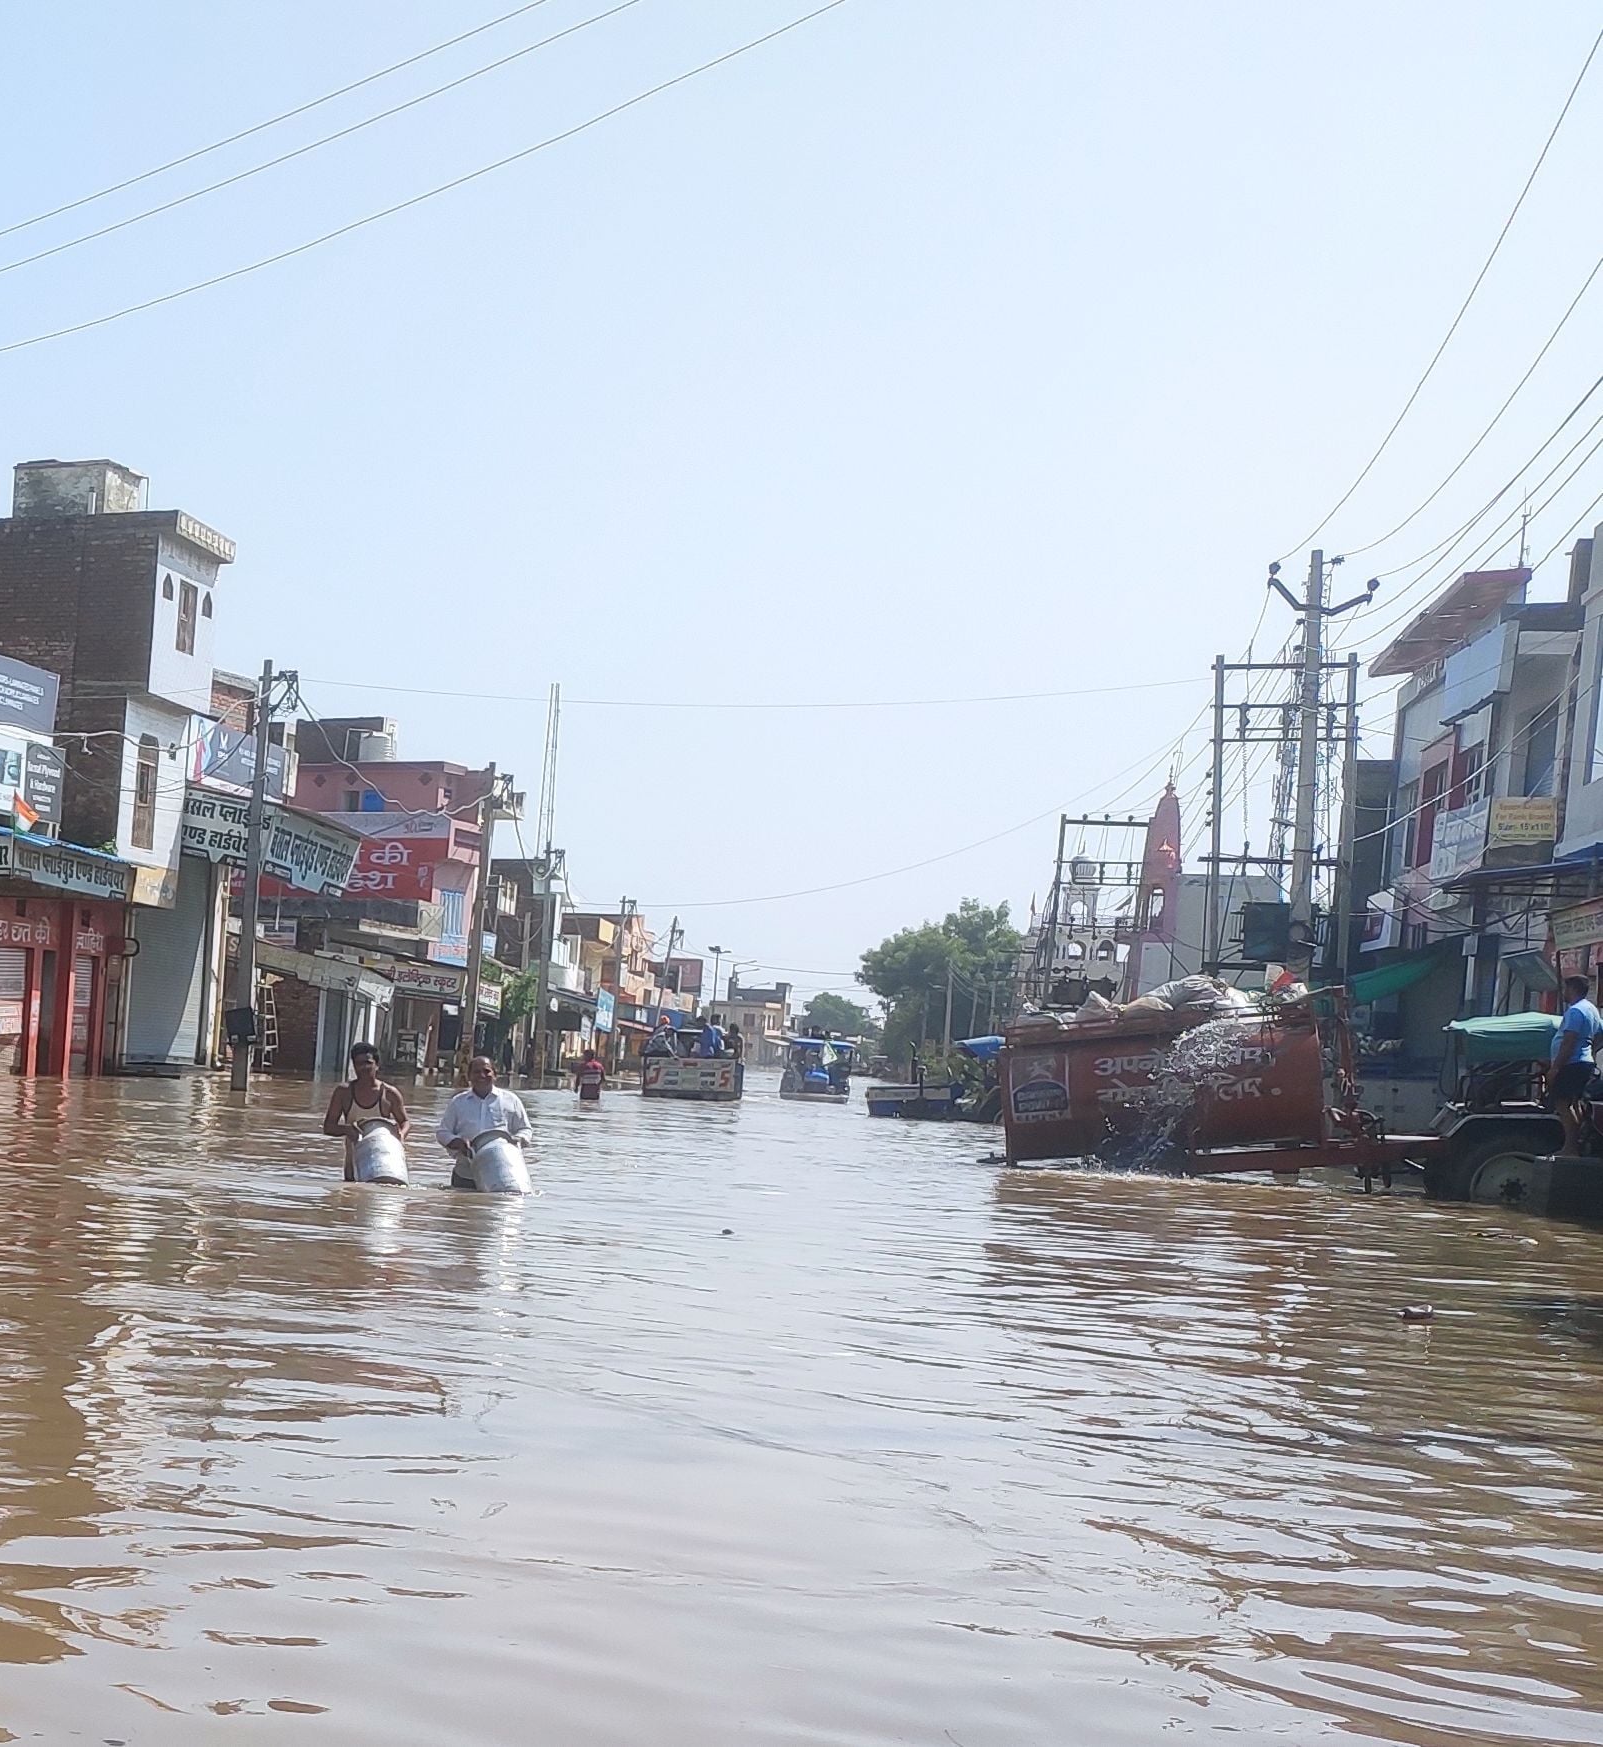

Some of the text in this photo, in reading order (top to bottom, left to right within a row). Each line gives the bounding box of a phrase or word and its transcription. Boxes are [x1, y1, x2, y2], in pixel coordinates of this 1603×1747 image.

[369, 841, 413, 867] की
[75, 863, 93, 884] एण्ड
[94, 860, 126, 891] हार्डवेयर
[11, 921, 31, 943] छत
[34, 916, 51, 945] की
